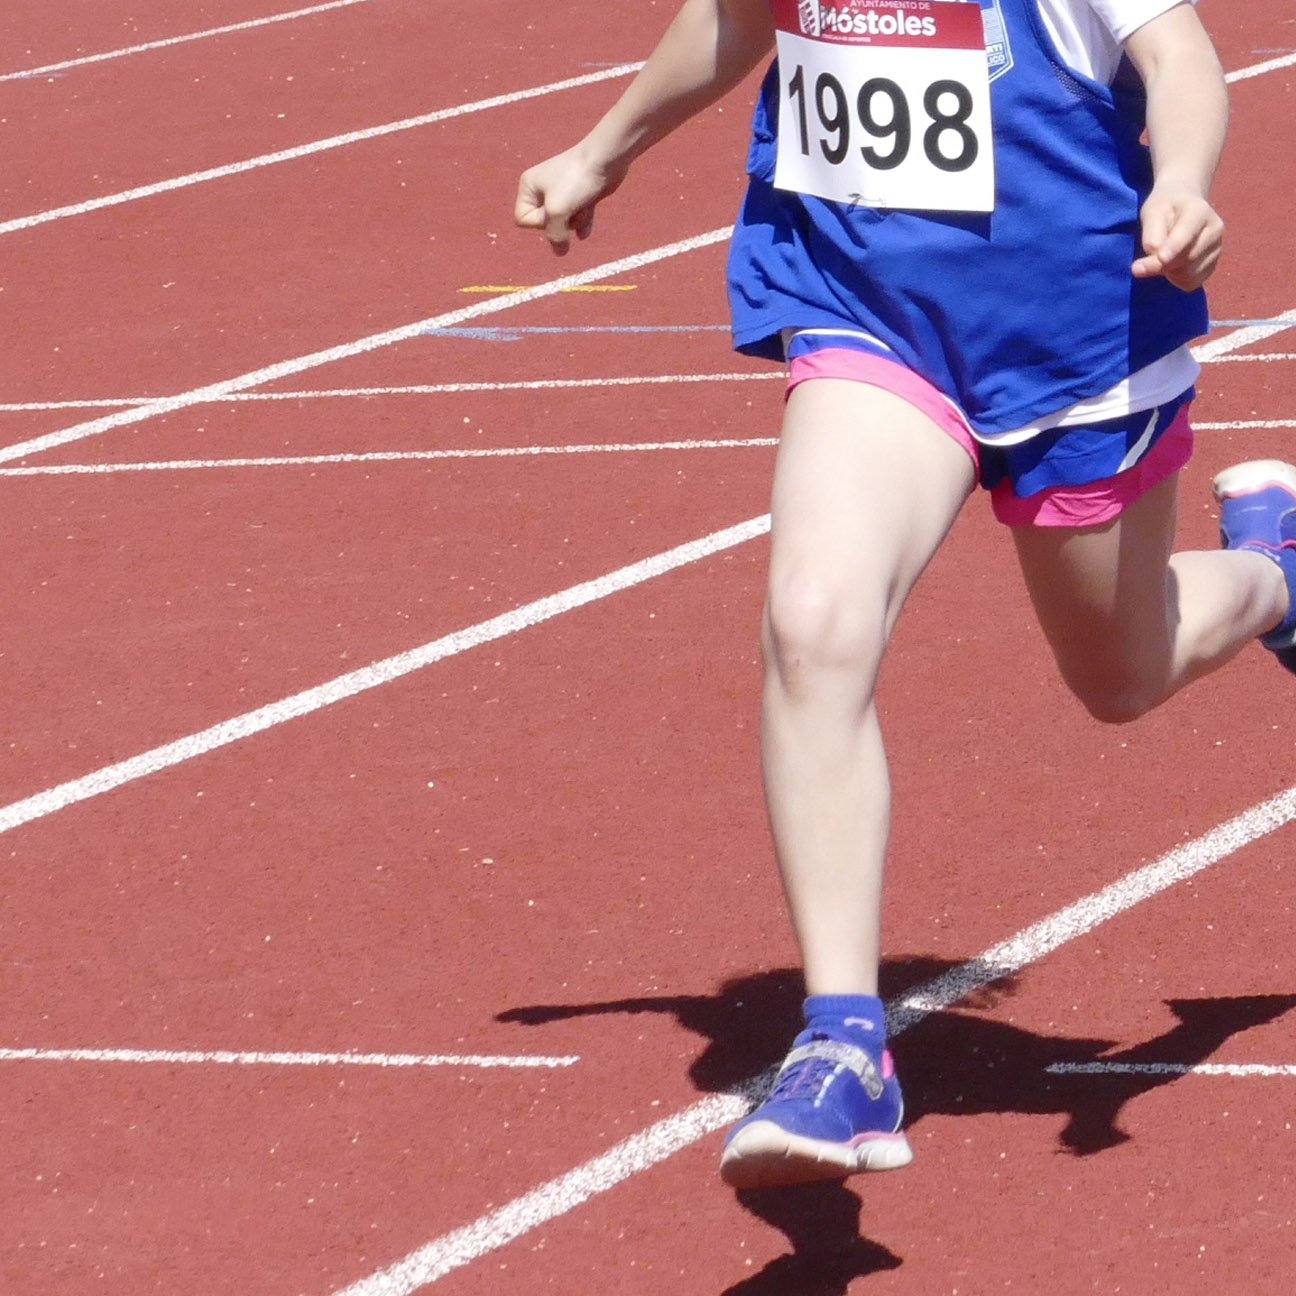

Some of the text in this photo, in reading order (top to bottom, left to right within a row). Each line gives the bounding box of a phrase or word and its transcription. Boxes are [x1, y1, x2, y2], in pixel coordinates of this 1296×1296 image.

[850, 0, 931, 11] AYUNTAMIENTO DE
[788, 64, 979, 173] 1998
